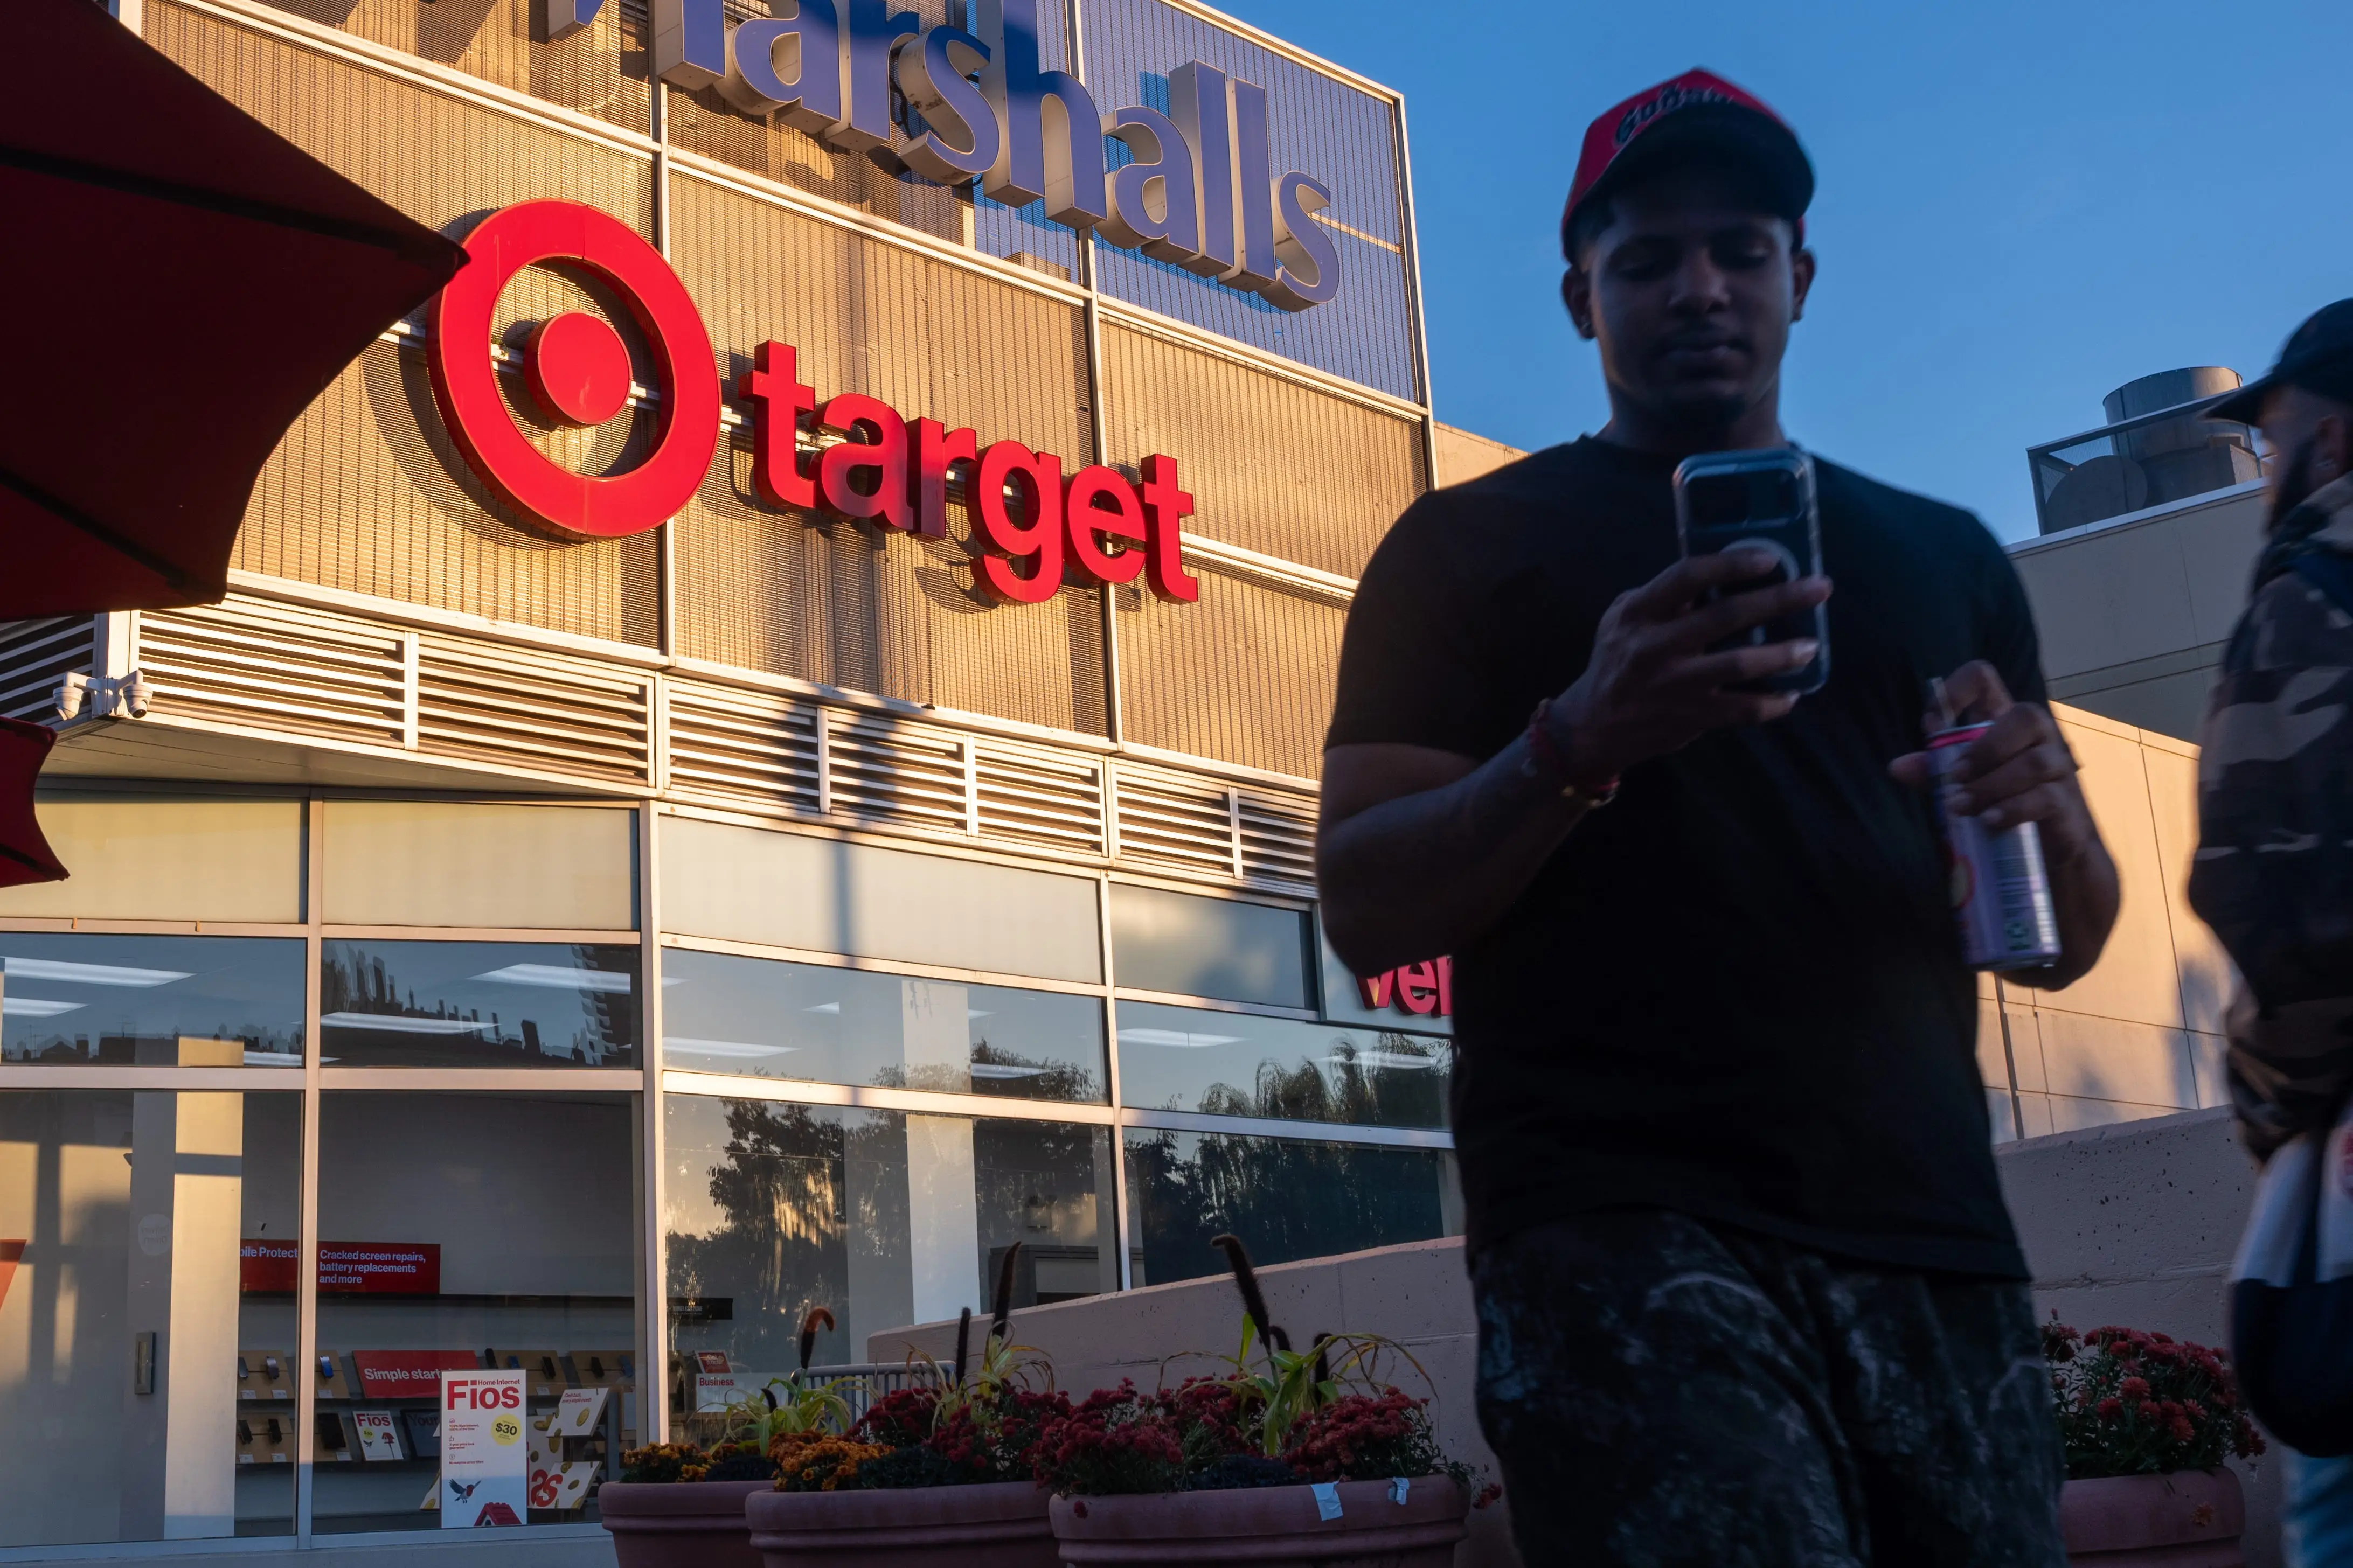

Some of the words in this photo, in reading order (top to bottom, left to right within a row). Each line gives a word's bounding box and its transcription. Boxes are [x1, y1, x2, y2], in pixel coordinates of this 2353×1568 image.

[549, 0, 1339, 312] arshalls
[739, 340, 1198, 605] target
[320, 1249, 358, 1260] Cracked
[360, 1252, 391, 1261] screen
[392, 1252, 426, 1263] repairs,
[320, 1262, 353, 1273] battery
[355, 1263, 417, 1273] replacements
[319, 1274, 337, 1283] and
[338, 1276, 362, 1284] more
[364, 1368, 409, 1382] Simple
[411, 1368, 442, 1379] start
[699, 1377, 734, 1386] Business
[447, 1379, 520, 1410] Fios
[356, 1413, 391, 1427] Fios
[496, 1423, 517, 1435] $30
